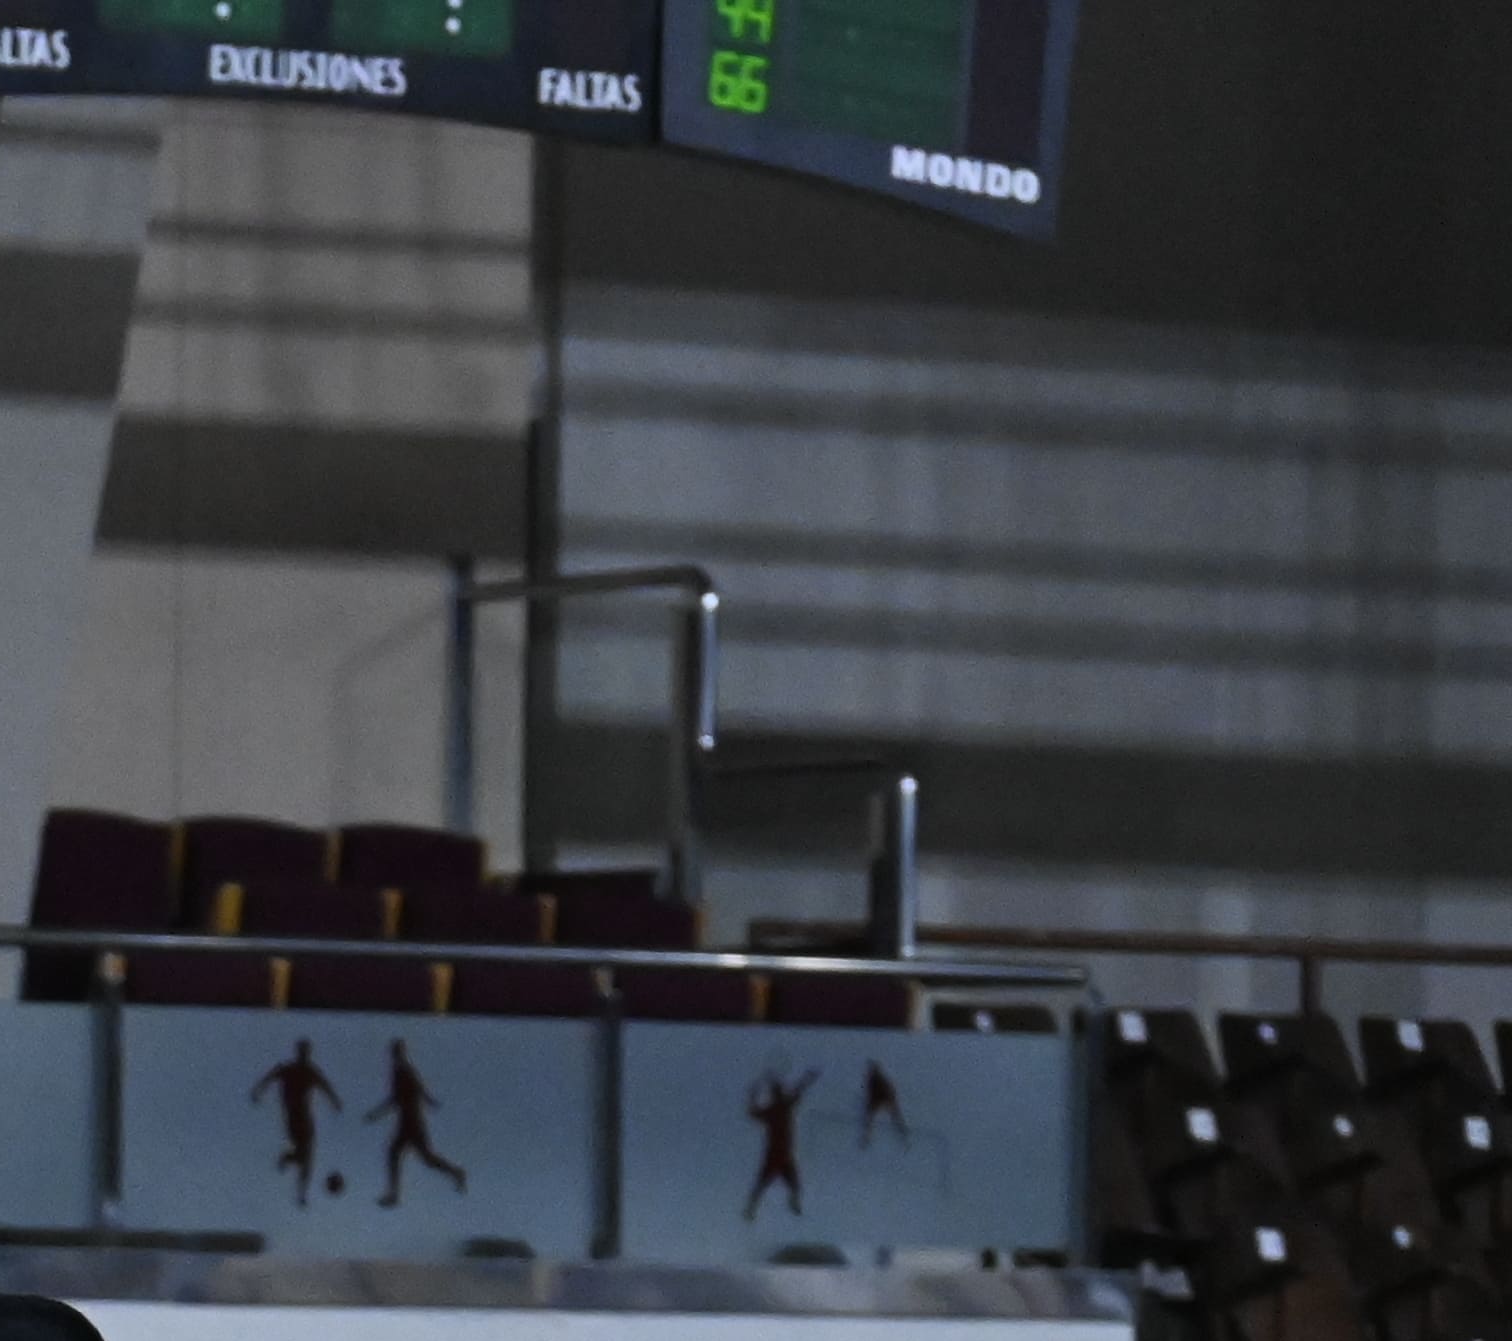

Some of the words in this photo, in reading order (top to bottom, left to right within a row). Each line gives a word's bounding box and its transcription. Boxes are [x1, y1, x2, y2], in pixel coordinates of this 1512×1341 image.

[207, 43, 407, 97] EXCLUSIONES
[537, 67, 643, 113] FALTAS
[708, 49, 771, 115] 66
[891, 145, 1041, 203] MONDO
